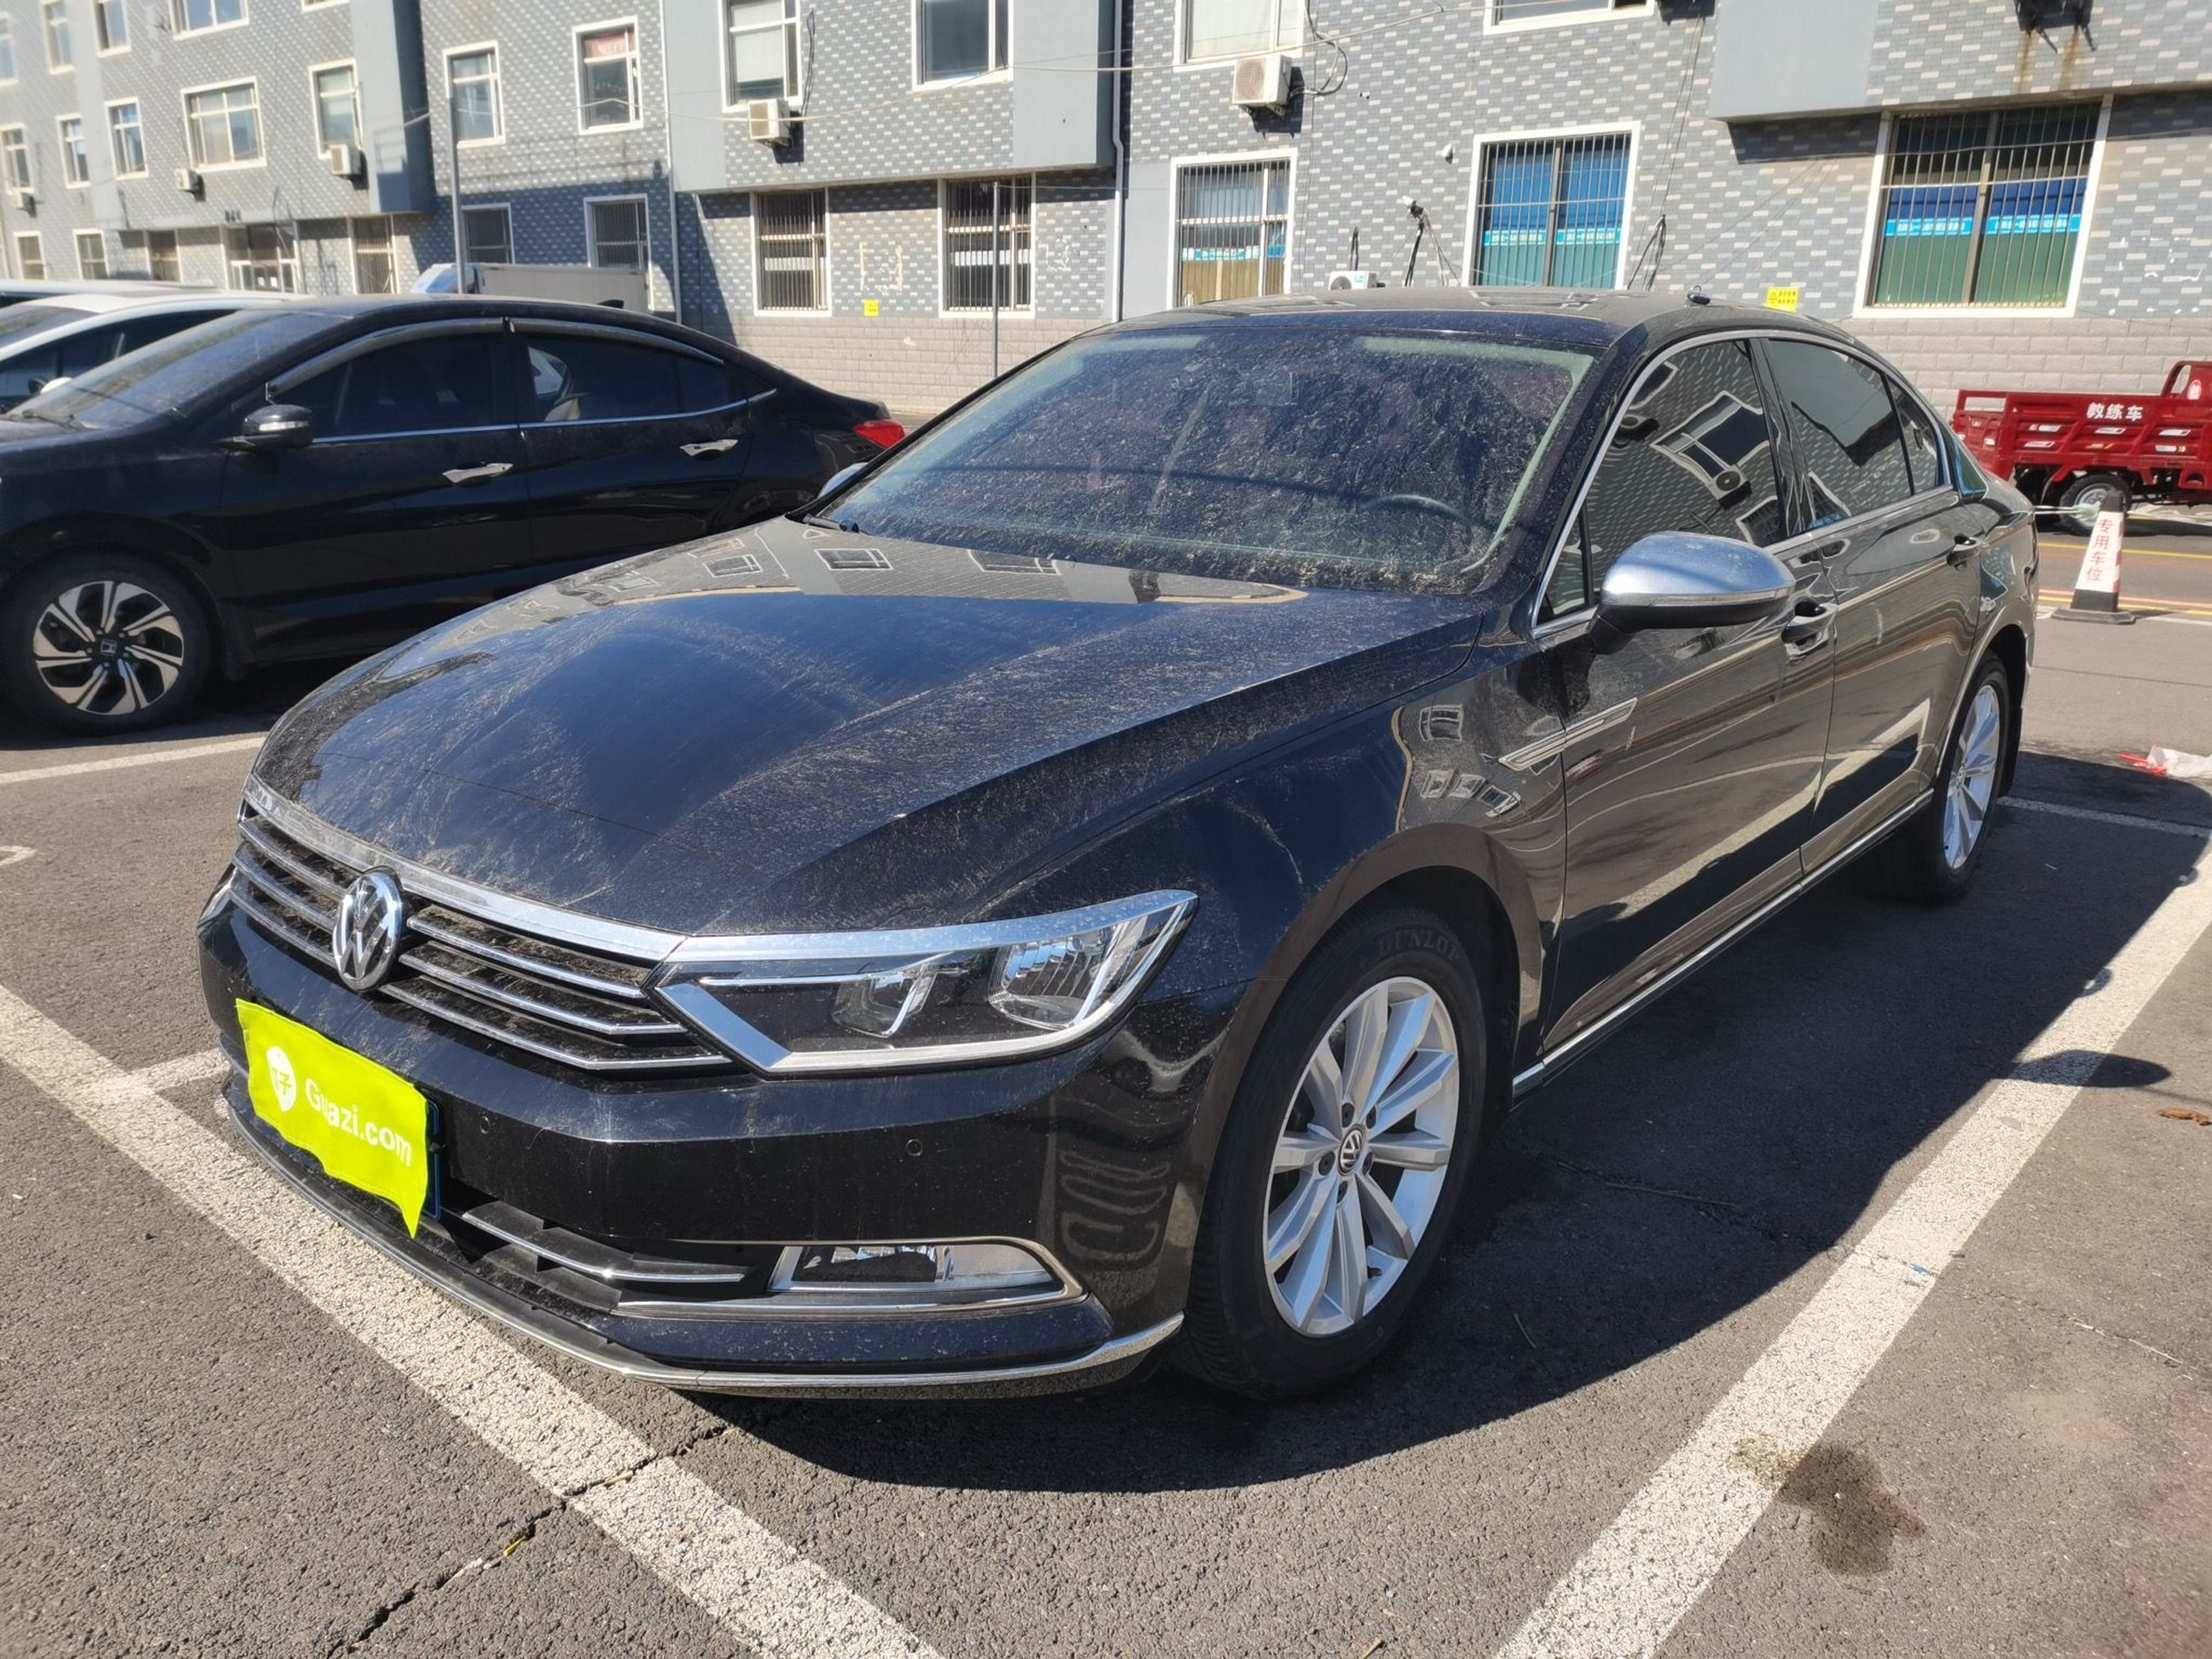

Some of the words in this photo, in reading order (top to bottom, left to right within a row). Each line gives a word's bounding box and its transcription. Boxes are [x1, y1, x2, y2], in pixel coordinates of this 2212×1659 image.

[2086, 402, 2143, 421] 教练车
[2087, 518, 2116, 581] 专用车位
[306, 1078, 412, 1166] Guazi.com
